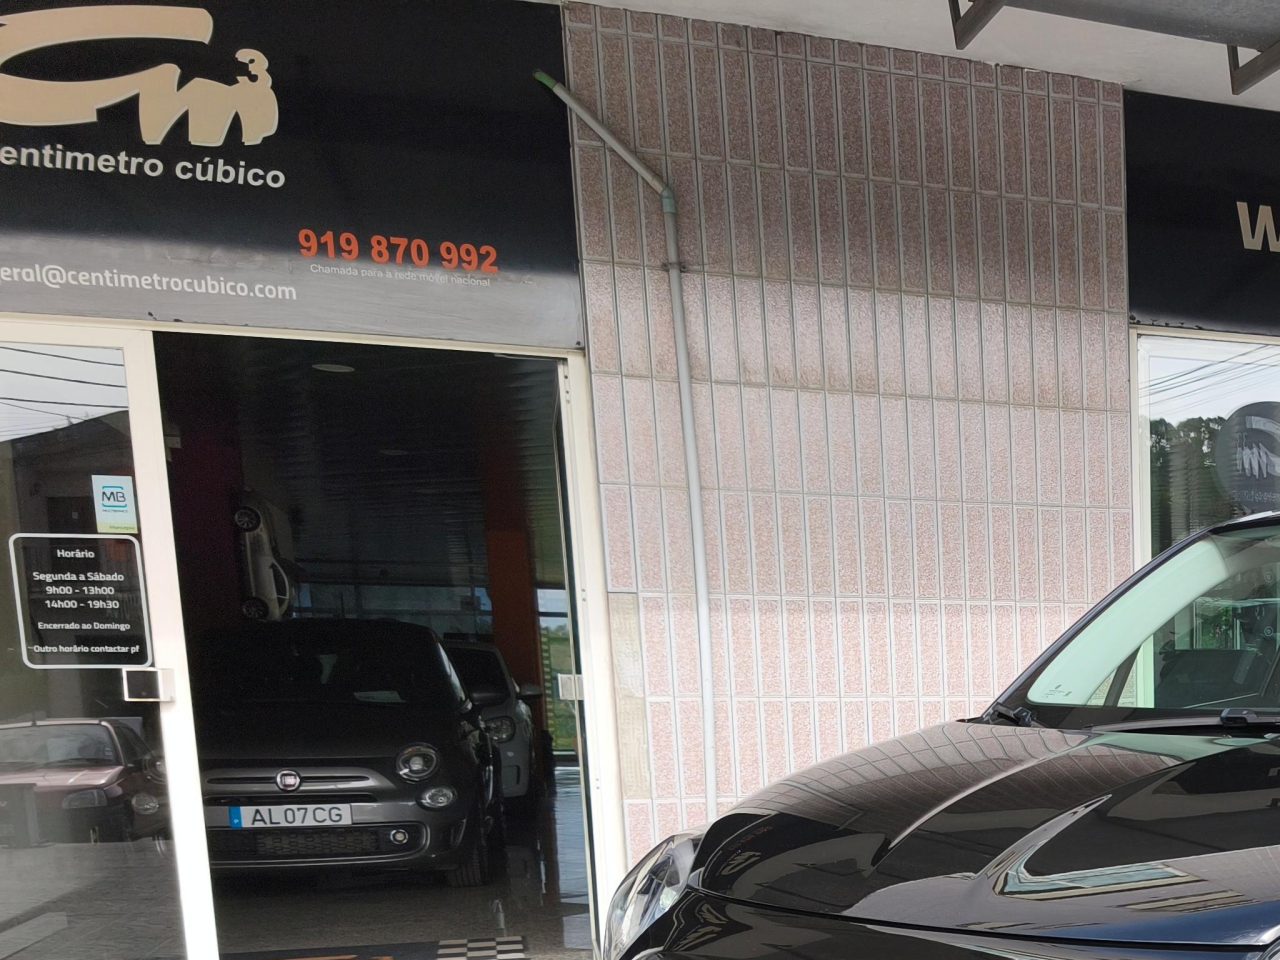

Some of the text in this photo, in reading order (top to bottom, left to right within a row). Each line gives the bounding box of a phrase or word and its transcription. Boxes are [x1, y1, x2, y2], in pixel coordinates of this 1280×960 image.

[0, 143, 286, 188] entimetro cúbico
[298, 229, 498, 274] 919 870 992
[0, 264, 297, 300] eral@centimetrocubico.com
[102, 491, 126, 502] MB
[56, 549, 95, 559] Horário
[32, 571, 77, 583] Segunda
[87, 572, 125, 581] Sábado
[45, 586, 72, 595] 9h00
[82, 586, 115, 595] 13h00
[44, 600, 77, 609] 14h00
[87, 600, 120, 609] 19h30
[37, 621, 80, 630] Encerrado
[93, 621, 131, 632] Domingo
[33, 644, 58, 653] Outro
[58, 643, 89, 653] horário
[90, 645, 129, 653] contactar
[251, 808, 281, 825] AL
[284, 807, 308, 824] 07
[313, 806, 343, 823] CG
